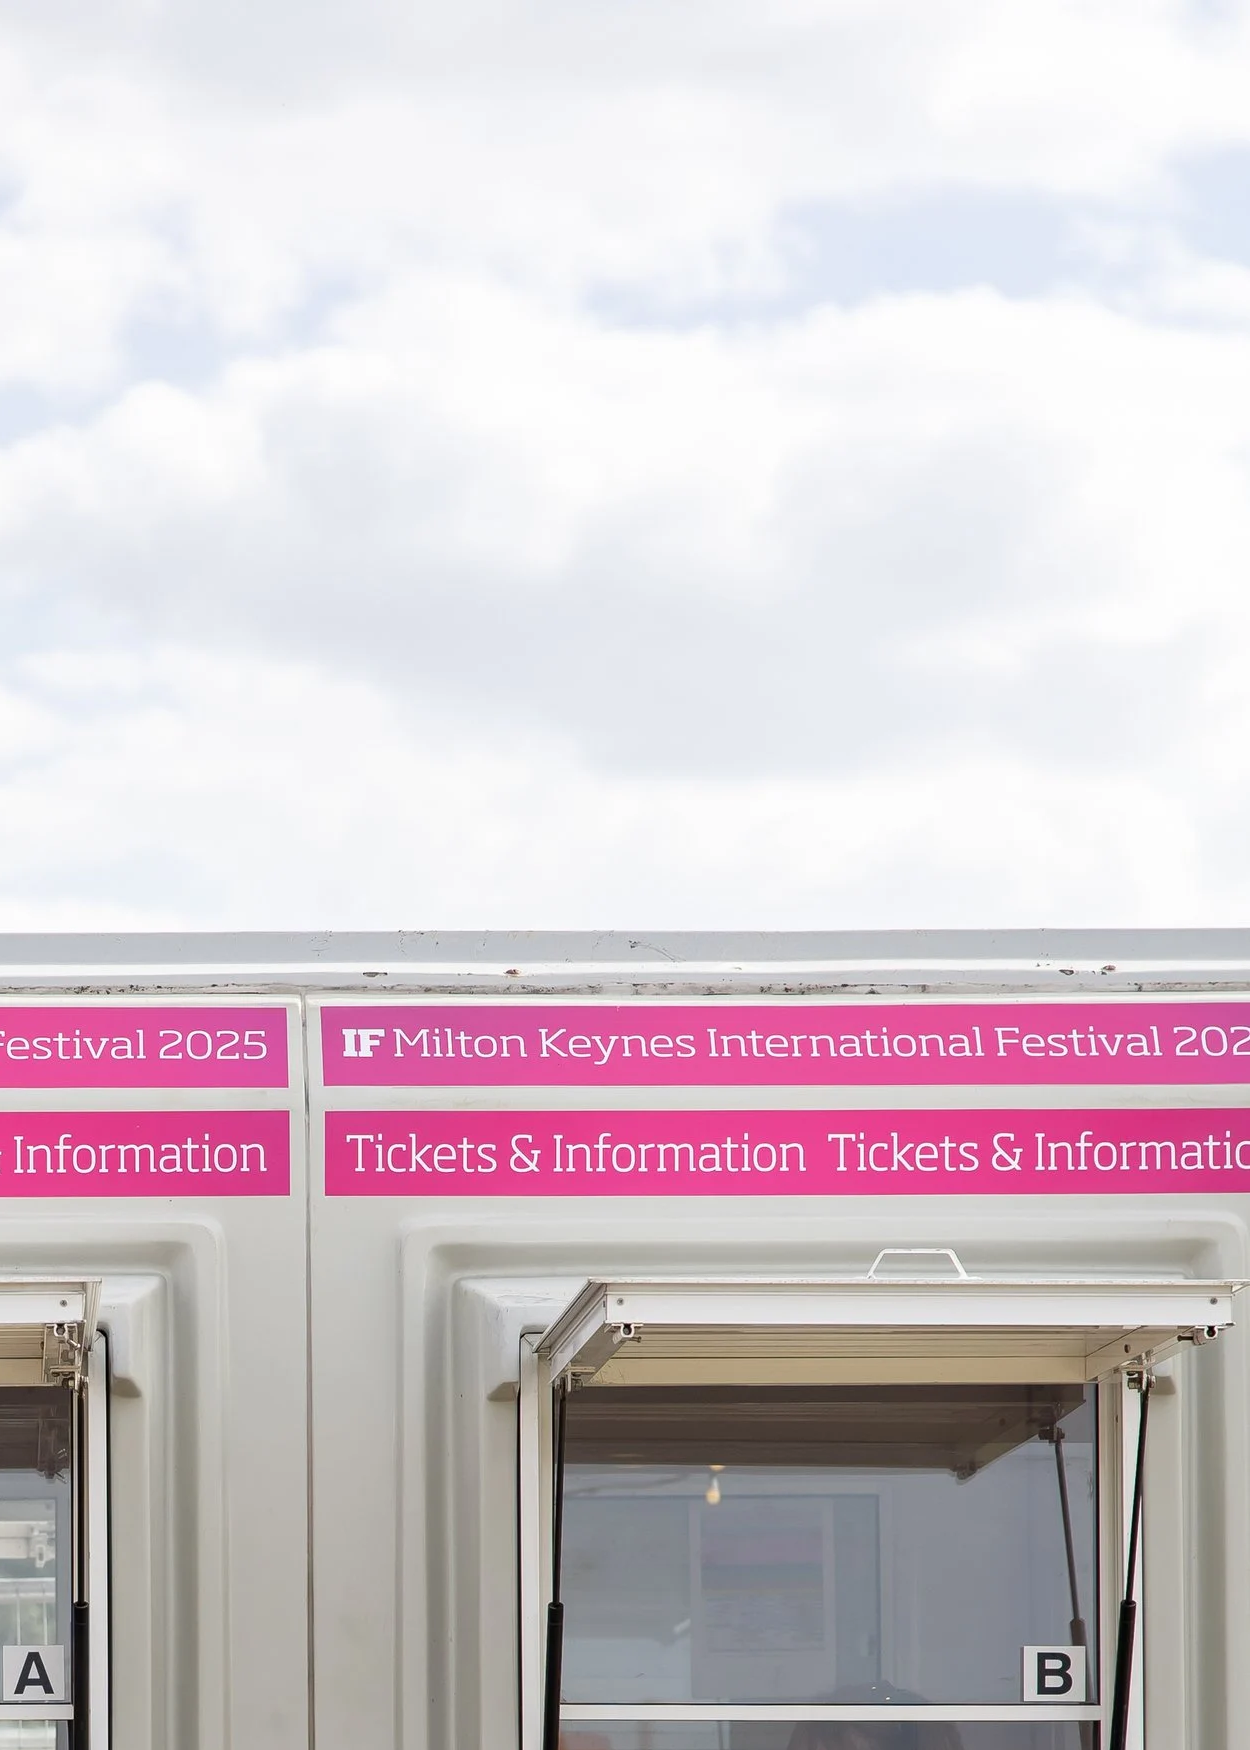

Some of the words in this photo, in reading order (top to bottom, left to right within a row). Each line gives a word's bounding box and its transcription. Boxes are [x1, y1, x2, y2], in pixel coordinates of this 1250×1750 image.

[160, 1029, 267, 1060] 2025
[341, 1028, 386, 1058] IF
[392, 1027, 528, 1058] Milton
[538, 1028, 696, 1065] Keynes
[707, 1026, 985, 1058] International
[995, 1025, 1163, 1057] Festival
[1173, 1025, 1250, 1057] 202
[13, 1133, 268, 1174] Information
[346, 1133, 498, 1173] Tickets
[509, 1134, 542, 1173] &
[553, 1132, 807, 1173] Information
[827, 1131, 980, 1172] Tickets
[991, 1132, 1024, 1172] &
[1034, 1130, 1250, 1171] Informatio
[13, 1651, 55, 1695] A
[1036, 1652, 1073, 1695] B
